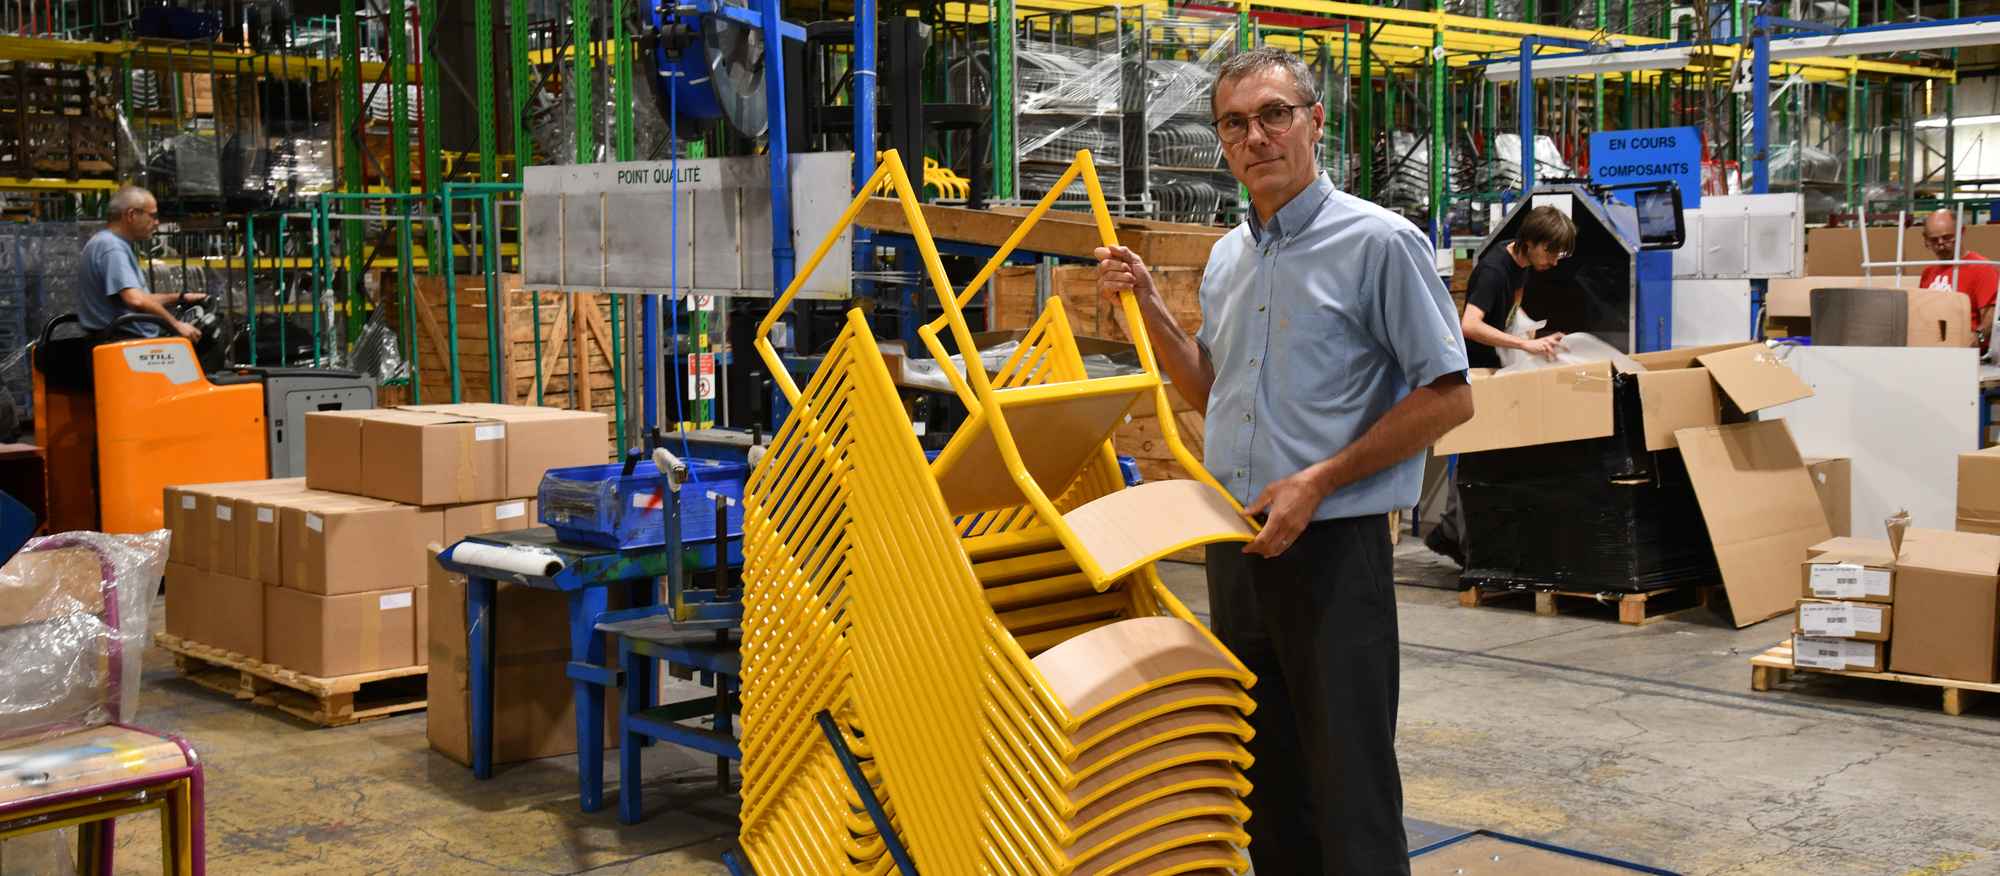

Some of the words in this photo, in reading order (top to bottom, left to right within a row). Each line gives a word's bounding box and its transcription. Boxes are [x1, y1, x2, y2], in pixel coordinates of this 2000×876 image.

[1609, 138, 1626, 150] EN
[1631, 136, 1677, 149] COURS
[1599, 163, 1689, 177] COMPOSANTS
[618, 170, 649, 185] POINT
